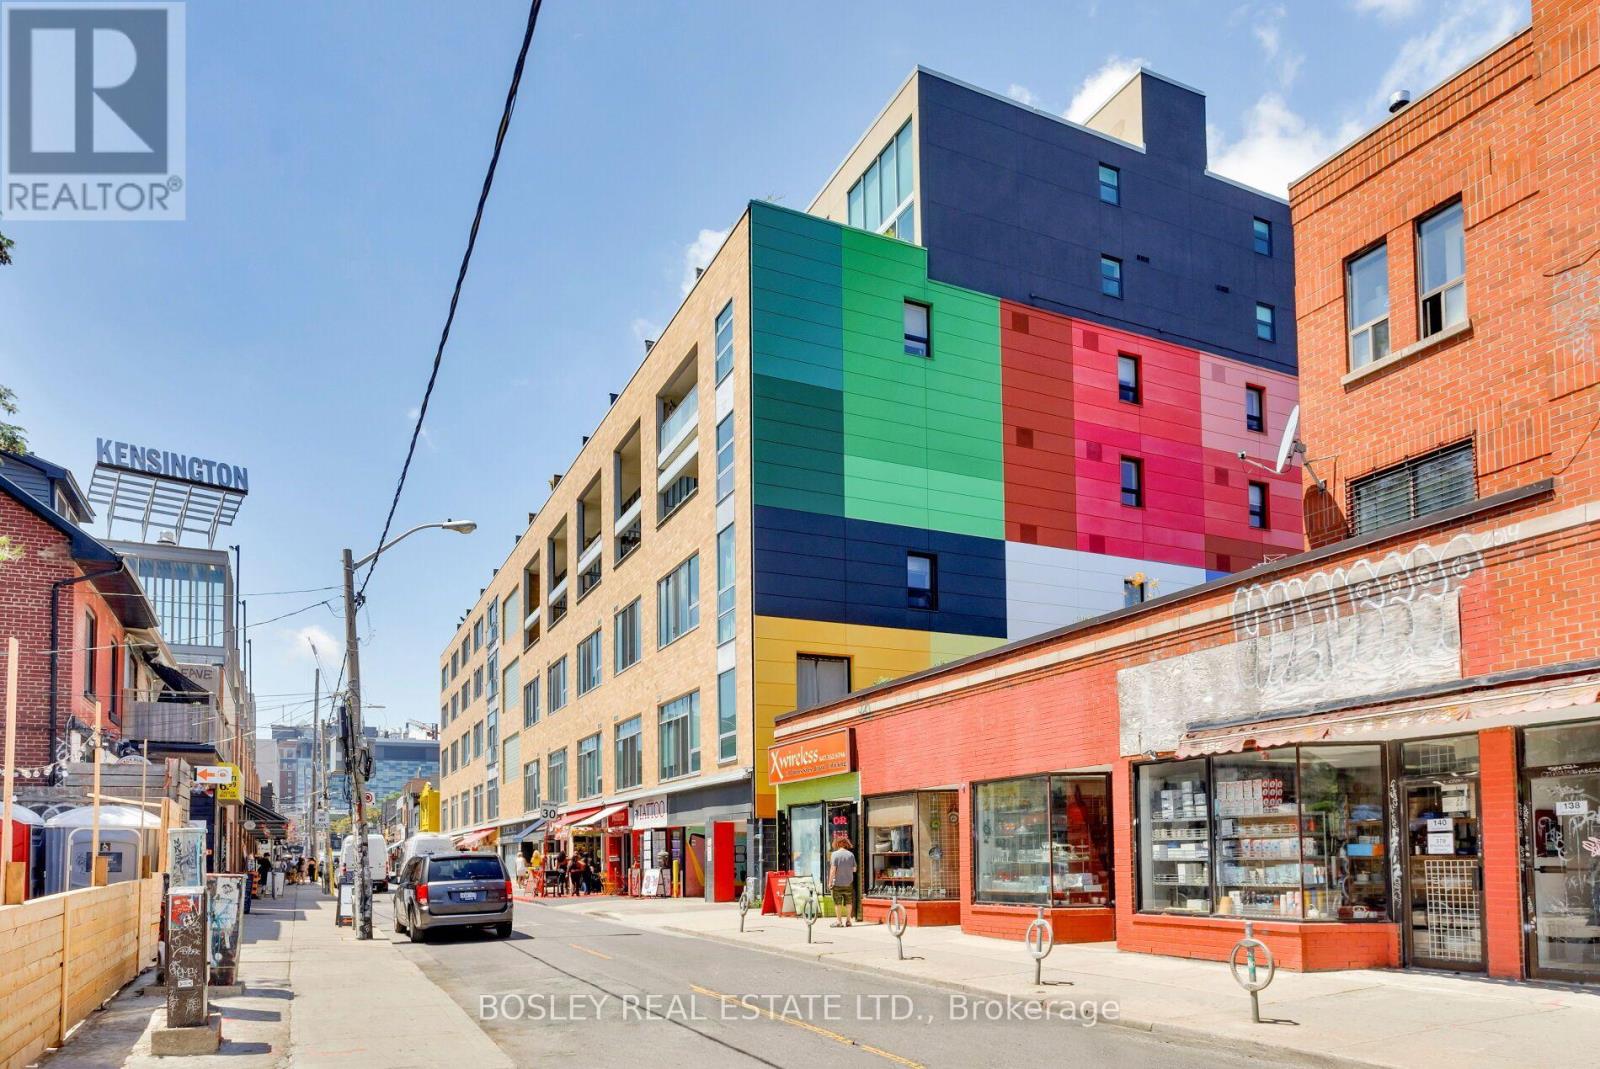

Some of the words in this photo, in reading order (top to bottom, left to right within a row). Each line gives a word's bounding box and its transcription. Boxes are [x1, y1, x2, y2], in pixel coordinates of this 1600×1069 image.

[96, 437, 248, 490] KENSINGTON
[639, 800, 665, 820] TATTOO
[1563, 801, 1581, 810] 138
[541, 808, 556, 819] 30
[1433, 819, 1447, 827] 140
